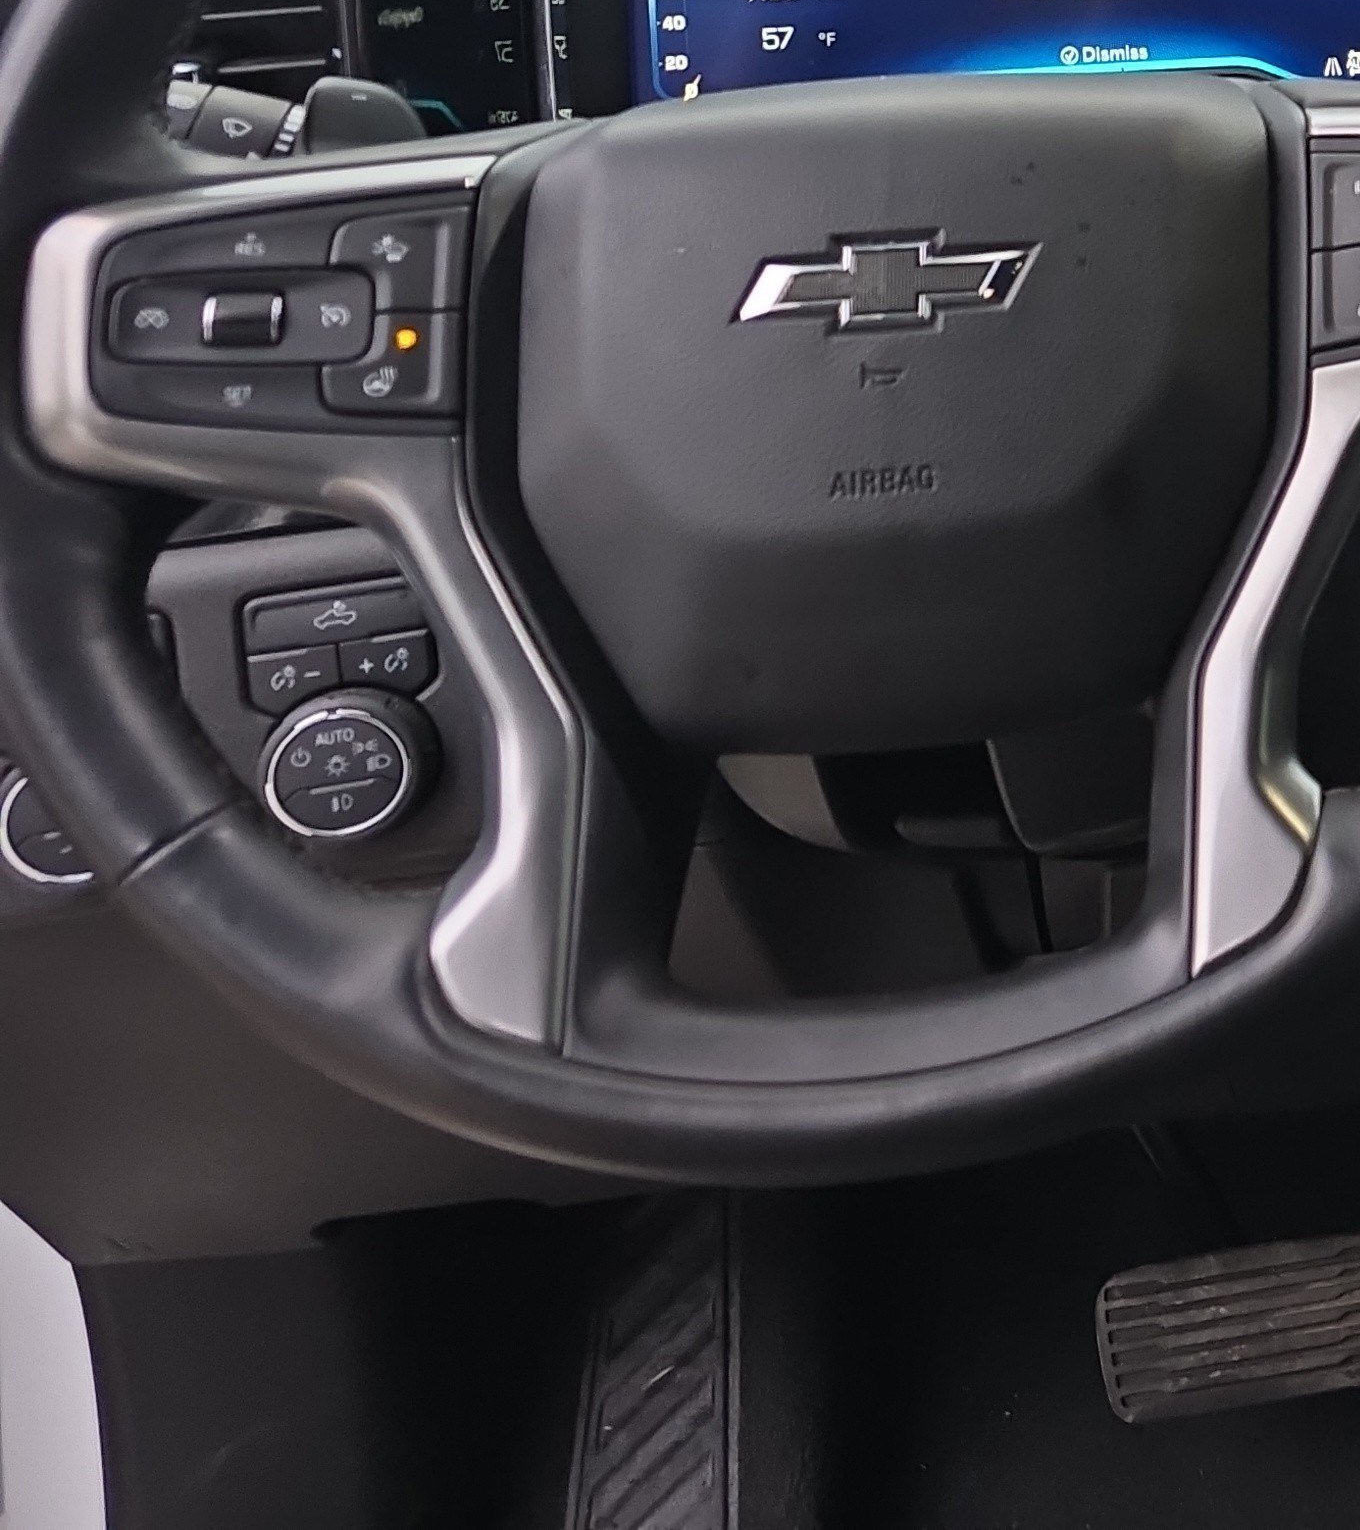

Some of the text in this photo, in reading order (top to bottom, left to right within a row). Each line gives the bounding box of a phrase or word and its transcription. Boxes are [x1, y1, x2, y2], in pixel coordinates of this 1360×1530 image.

[662, 15, 686, 31] 40
[761, 26, 795, 50] 57
[664, 55, 689, 71] 20
[1082, 44, 1149, 63] Dismiss
[828, 464, 937, 500] AIRBAG
[315, 727, 355, 747] AUTO
